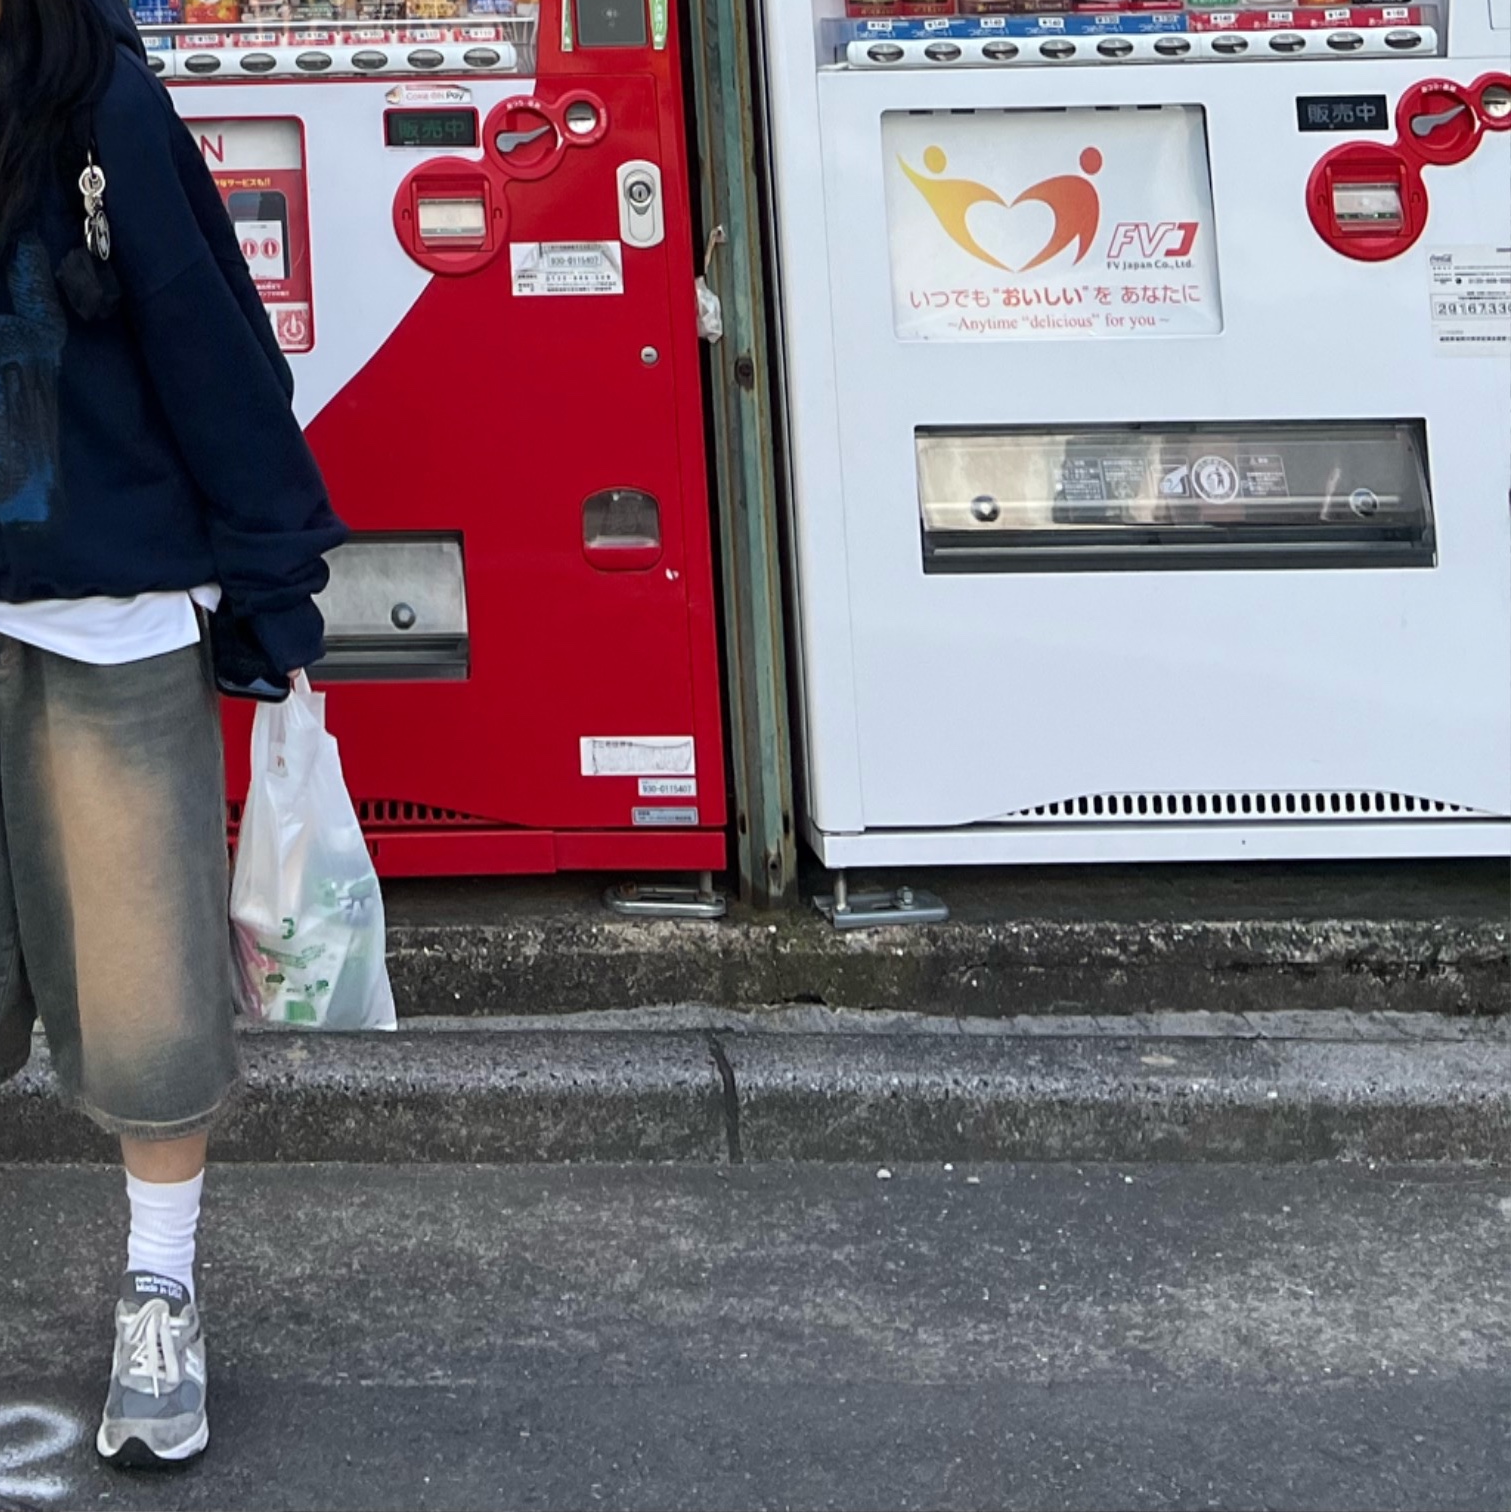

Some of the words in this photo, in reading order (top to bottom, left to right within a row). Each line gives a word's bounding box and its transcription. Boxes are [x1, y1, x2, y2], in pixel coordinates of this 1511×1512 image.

[406, 92, 428, 100] Coke
[446, 90, 465, 102] Pay
[1307, 103, 1376, 124] 販売中
[398, 120, 464, 139] 販売中
[1107, 222, 1199, 258] FVJ
[1107, 260, 1120, 270] FV
[1122, 260, 1153, 271] Japan
[1120, 285, 1201, 304] あなたに
[1105, 314, 1125, 327] for
[1128, 317, 1156, 332] you
[642, 784, 692, 795] 930-0115407
[135, 1285, 158, 1294] Made
